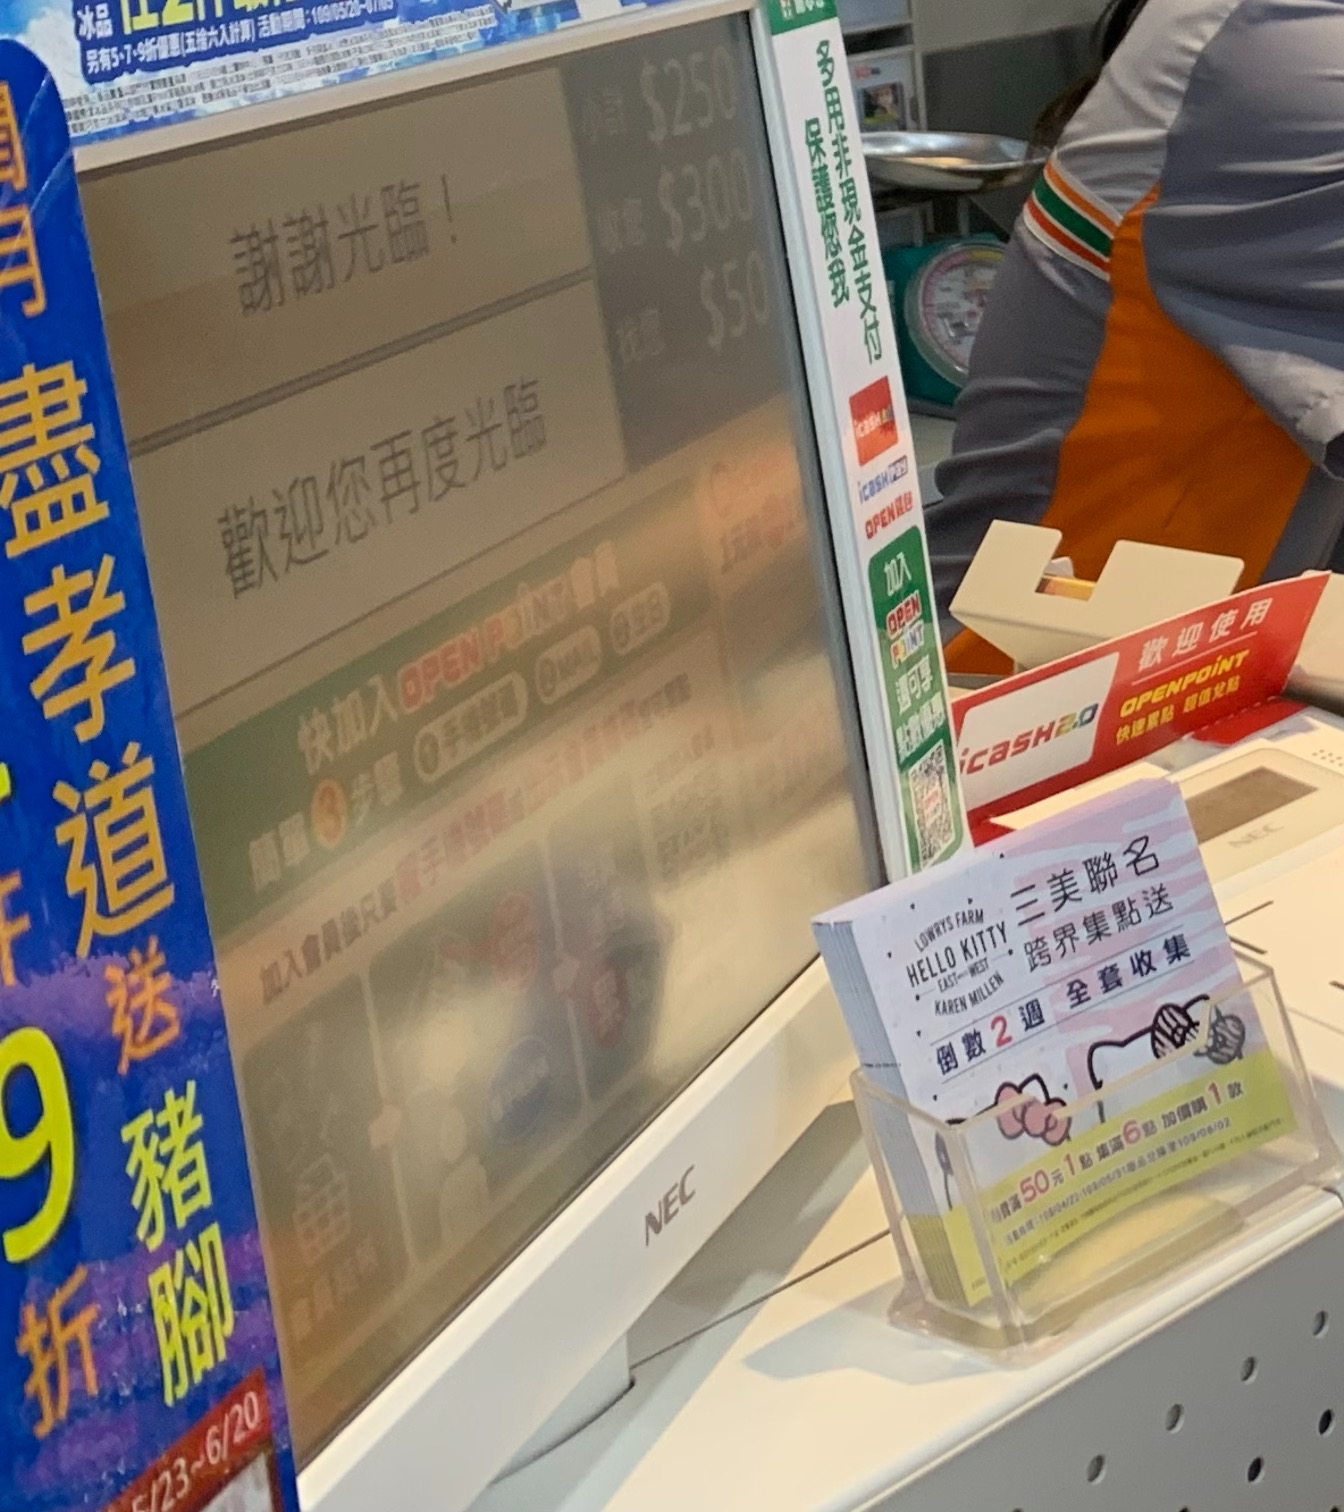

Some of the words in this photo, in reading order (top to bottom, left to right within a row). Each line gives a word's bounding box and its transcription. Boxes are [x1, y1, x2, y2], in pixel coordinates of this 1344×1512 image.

[77, 2, 114, 40] 冰品
[657, 149, 751, 255] $300
[804, 117, 850, 309] 保護您我
[816, 39, 883, 365] 多用非現金支付
[701, 250, 770, 356] $50
[217, 376, 548, 599] 歡迎您再度光臨
[883, 551, 913, 596] 加入
[886, 589, 922, 638] OPEN
[1139, 597, 1273, 672] 歡迎使用
[1009, 834, 1160, 927] 三美聯名
[906, 943, 957, 988] HELLO
[961, 920, 1009, 958] KITTY
[914, 915, 954, 953] LOWRYS
[955, 908, 984, 928] FARM
[1022, 883, 1174, 973] 跨界集點送
[934, 999, 968, 1017] KAREN
[969, 970, 1005, 1007] MILLEN
[936, 997, 1046, 1075] 倒數2週
[1066, 933, 1191, 1010] 全套收集
[937, 972, 959, 993] EAST
[969, 957, 990, 978] WEST
[643, 1165, 697, 1248] NEC
